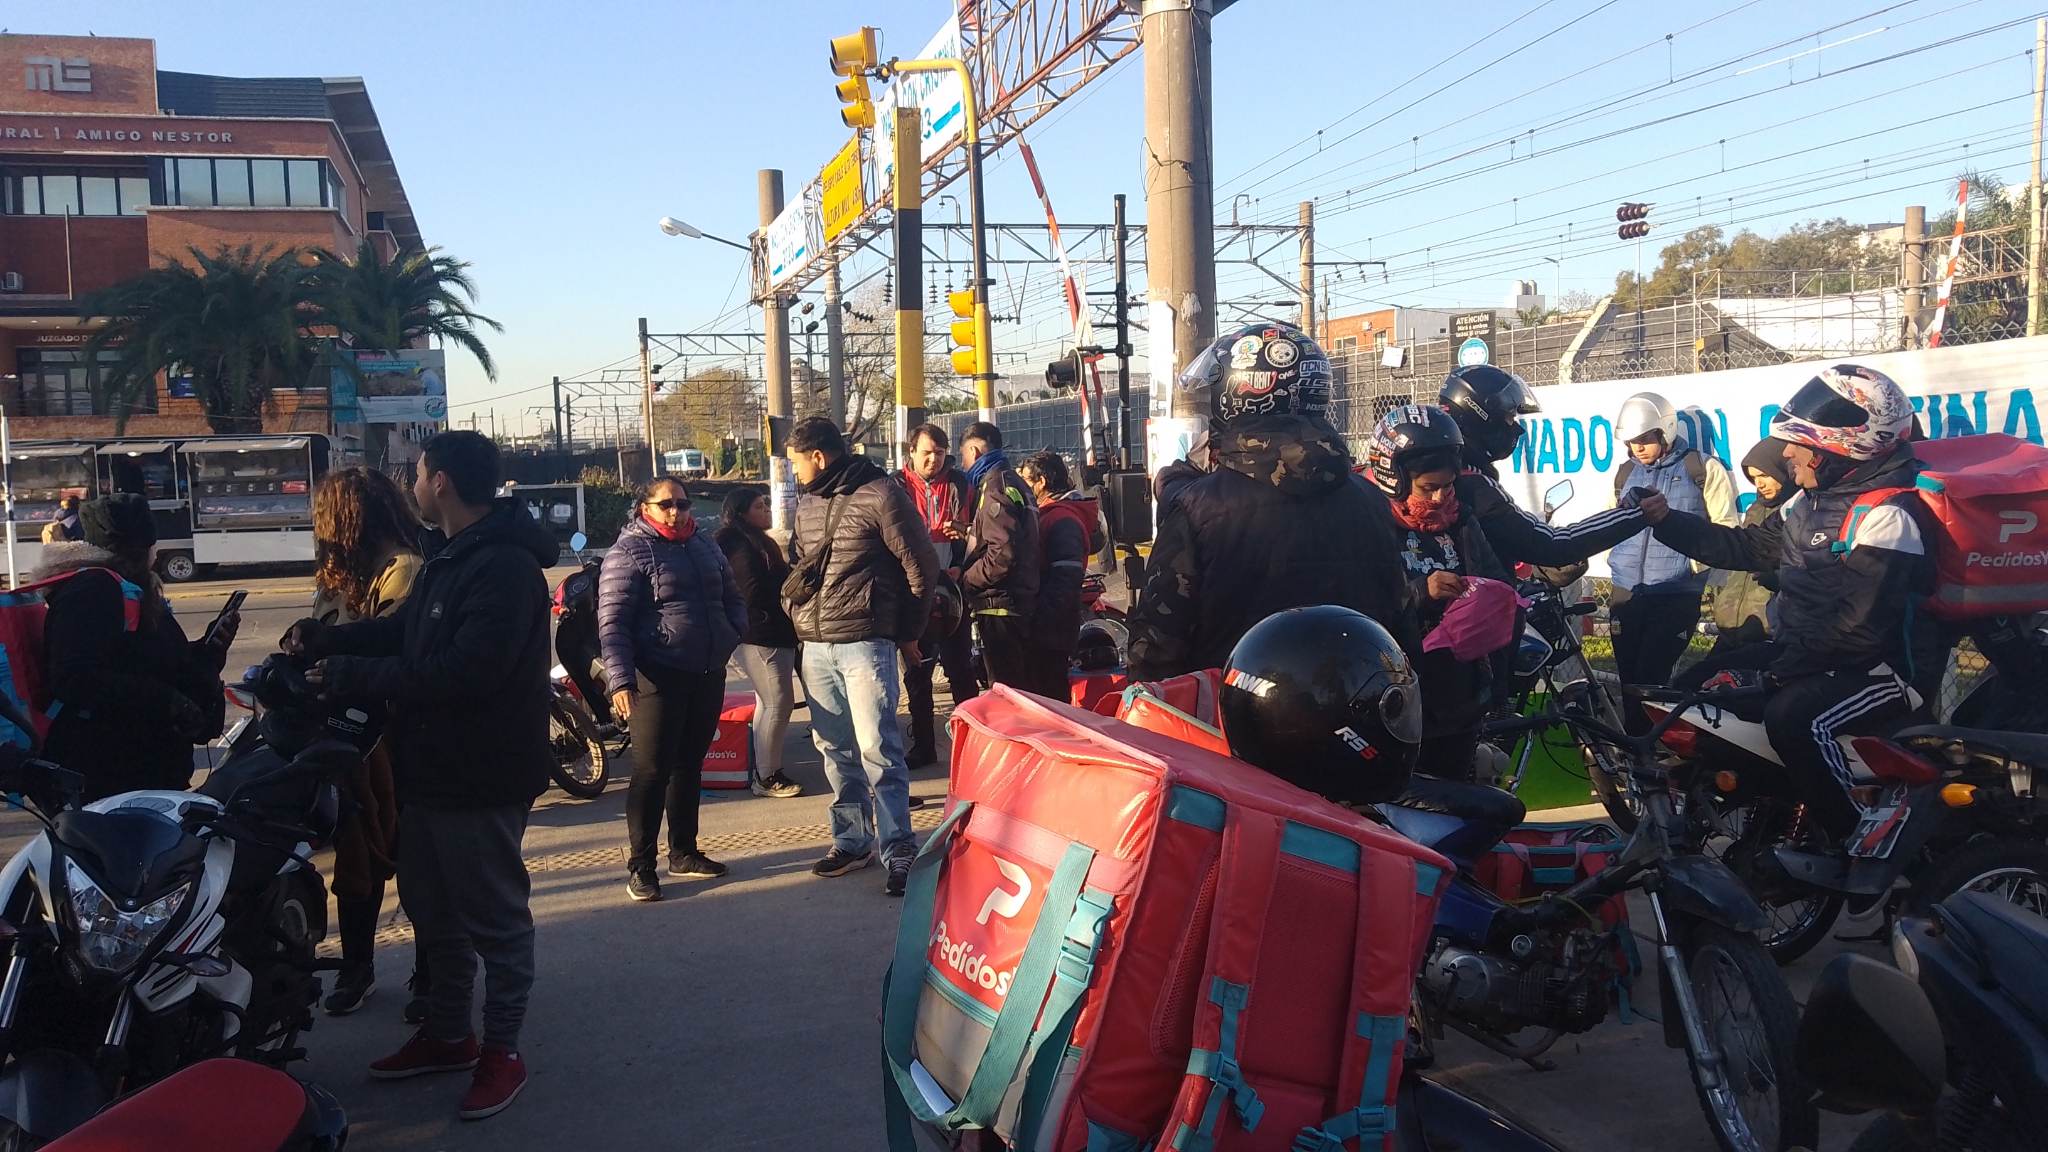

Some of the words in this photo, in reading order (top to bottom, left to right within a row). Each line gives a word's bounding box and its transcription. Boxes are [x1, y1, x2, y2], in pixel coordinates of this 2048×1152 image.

[0, 126, 43, 138] RAL
[75, 129, 141, 141] AMIGO
[152, 131, 233, 143] NESTOR
[1456, 313, 1489, 326] ATENCIÓN
[37, 334, 80, 343] JUZGADO
[1512, 415, 1613, 473] WADO
[1966, 551, 2048, 568] PedidosY
[929, 920, 1017, 996] Pedidos
